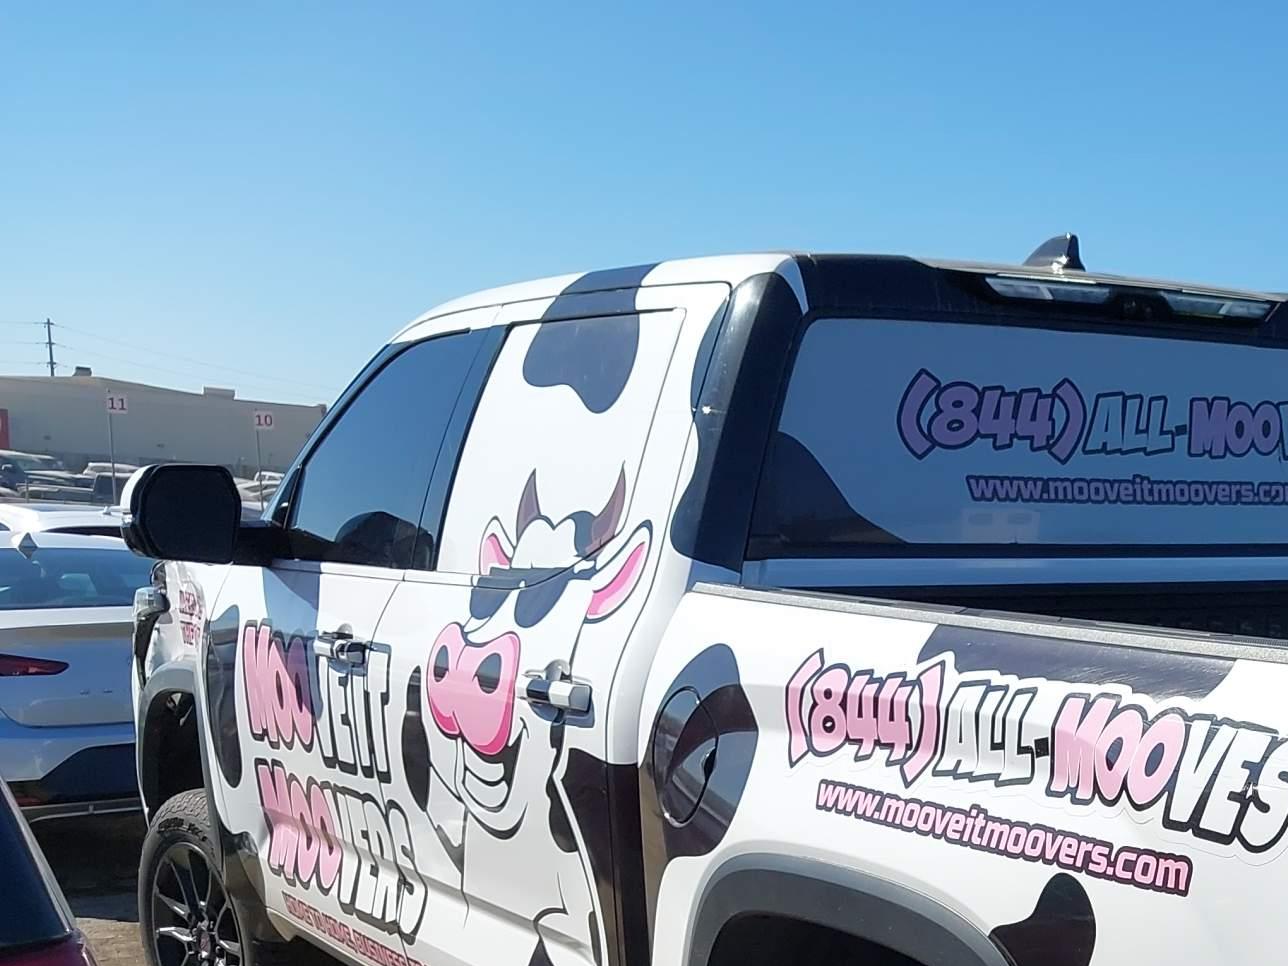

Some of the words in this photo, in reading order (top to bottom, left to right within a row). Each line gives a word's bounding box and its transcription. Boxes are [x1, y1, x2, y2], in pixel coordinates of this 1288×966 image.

[108, 397, 126, 411] 11
[255, 414, 273, 427] 10
[897, 368, 1087, 465] (844)
[786, 647, 946, 788] (844)
[254, 757, 428, 945] MOOVERS
[816, 780, 1193, 897] www.mooveitmoovers.com
